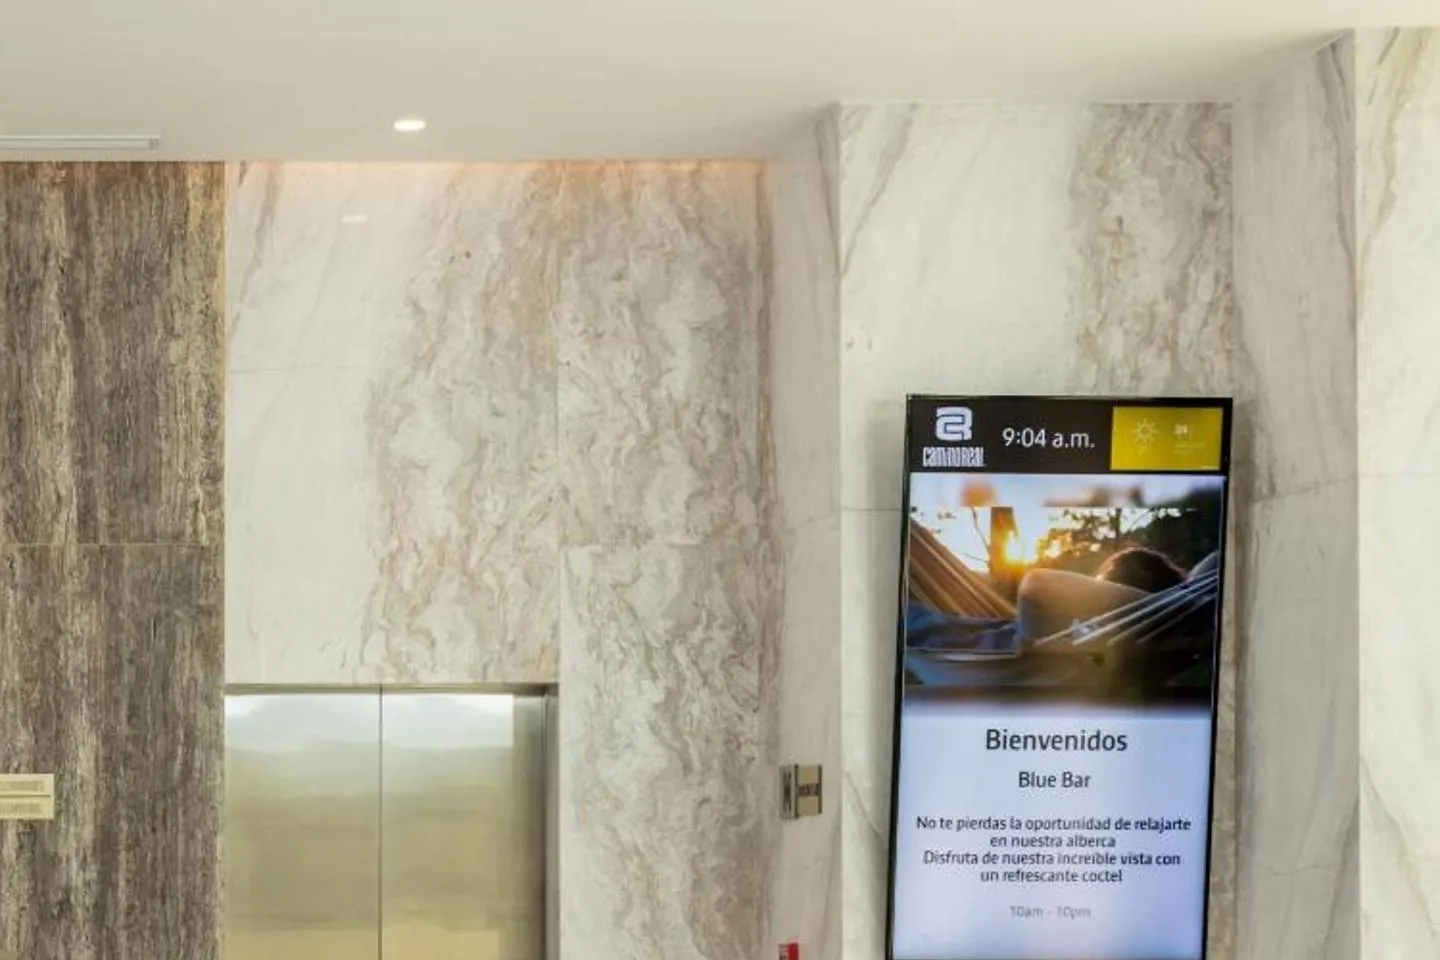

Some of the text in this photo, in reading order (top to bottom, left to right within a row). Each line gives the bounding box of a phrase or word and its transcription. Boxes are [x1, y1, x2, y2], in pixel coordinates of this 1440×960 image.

[1002, 427, 1095, 449] 9:04 a.m.
[986, 728, 1128, 751] Bienvenidos
[1018, 771, 1091, 788] Blue Bar
[916, 816, 1191, 834] No te pierdas la oportunidad de relajarte
[990, 834, 1116, 847] en nuestra alberca
[923, 850, 978, 865] Disfruta
[982, 851, 999, 865] de
[1001, 852, 1054, 865] nuestra
[1121, 851, 1152, 865] vista
[1155, 854, 1181, 865] con
[980, 871, 999, 882] un
[1002, 869, 1078, 882] refrescante
[1010, 905, 1043, 918] 10am
[1057, 905, 1091, 920] 10pm
